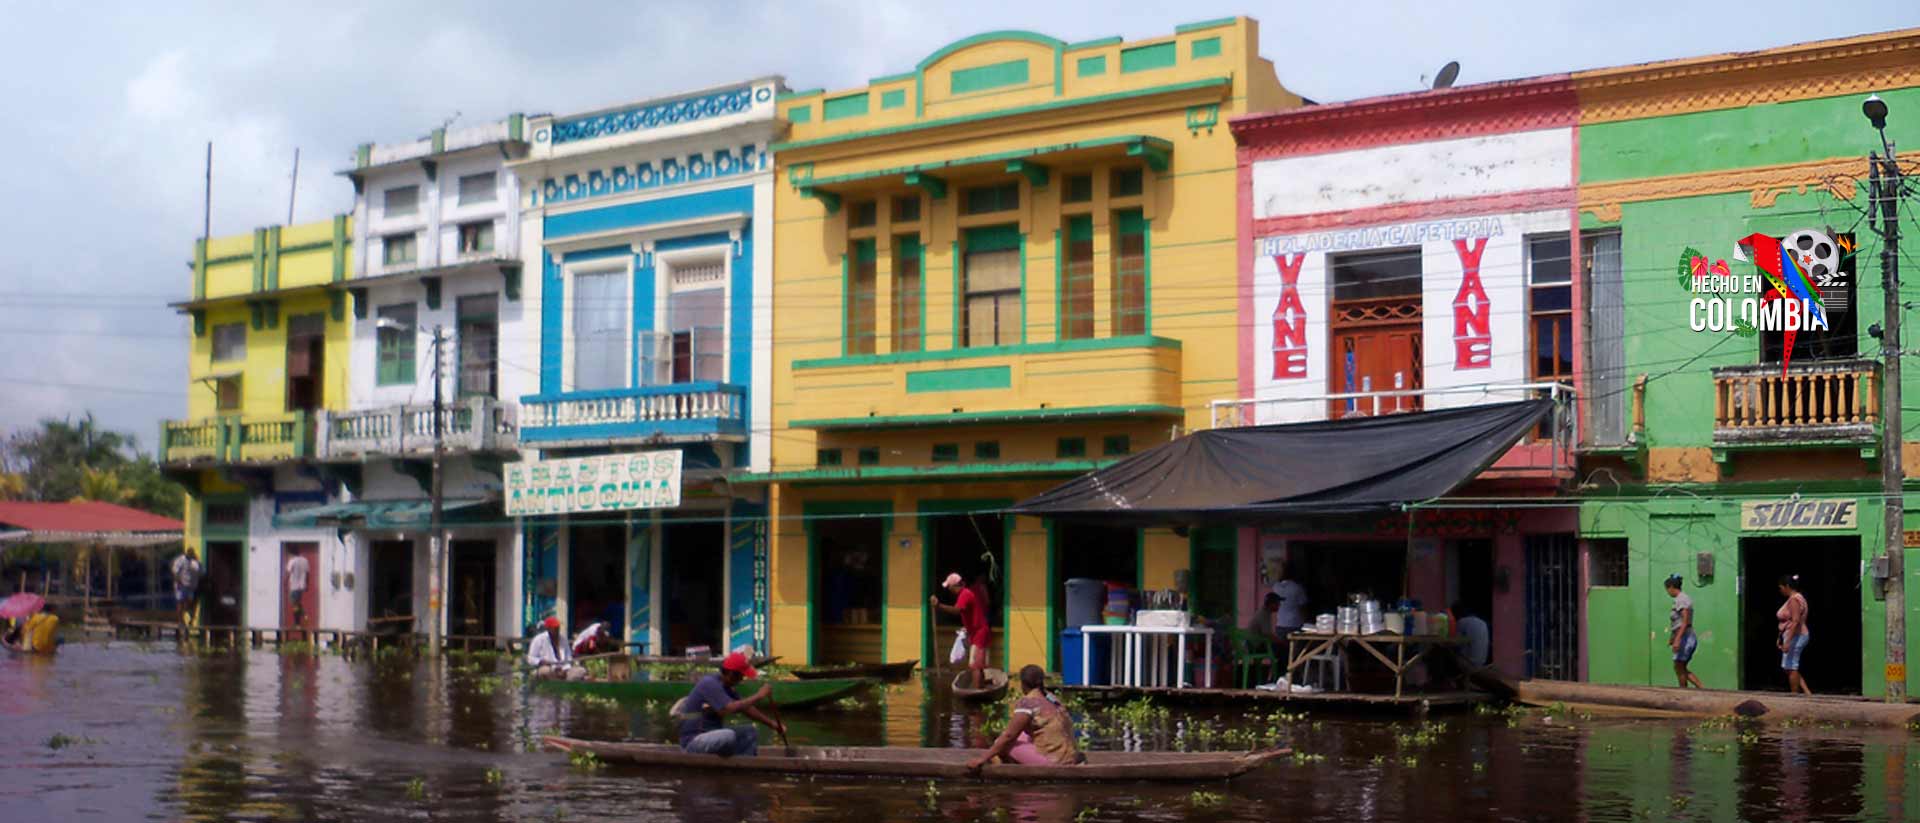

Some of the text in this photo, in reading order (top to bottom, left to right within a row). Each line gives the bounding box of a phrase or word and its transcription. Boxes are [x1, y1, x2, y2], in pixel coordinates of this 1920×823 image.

[1263, 226, 1382, 257] HELADERIA
[1391, 217, 1504, 245] CAFETERIA
[1272, 251, 1308, 381] VANE
[1452, 237, 1492, 371] VANE
[509, 452, 677, 489] ABASTOS
[509, 479, 675, 514] ANTIOQUIA
[1749, 500, 1857, 527] SUCRE
